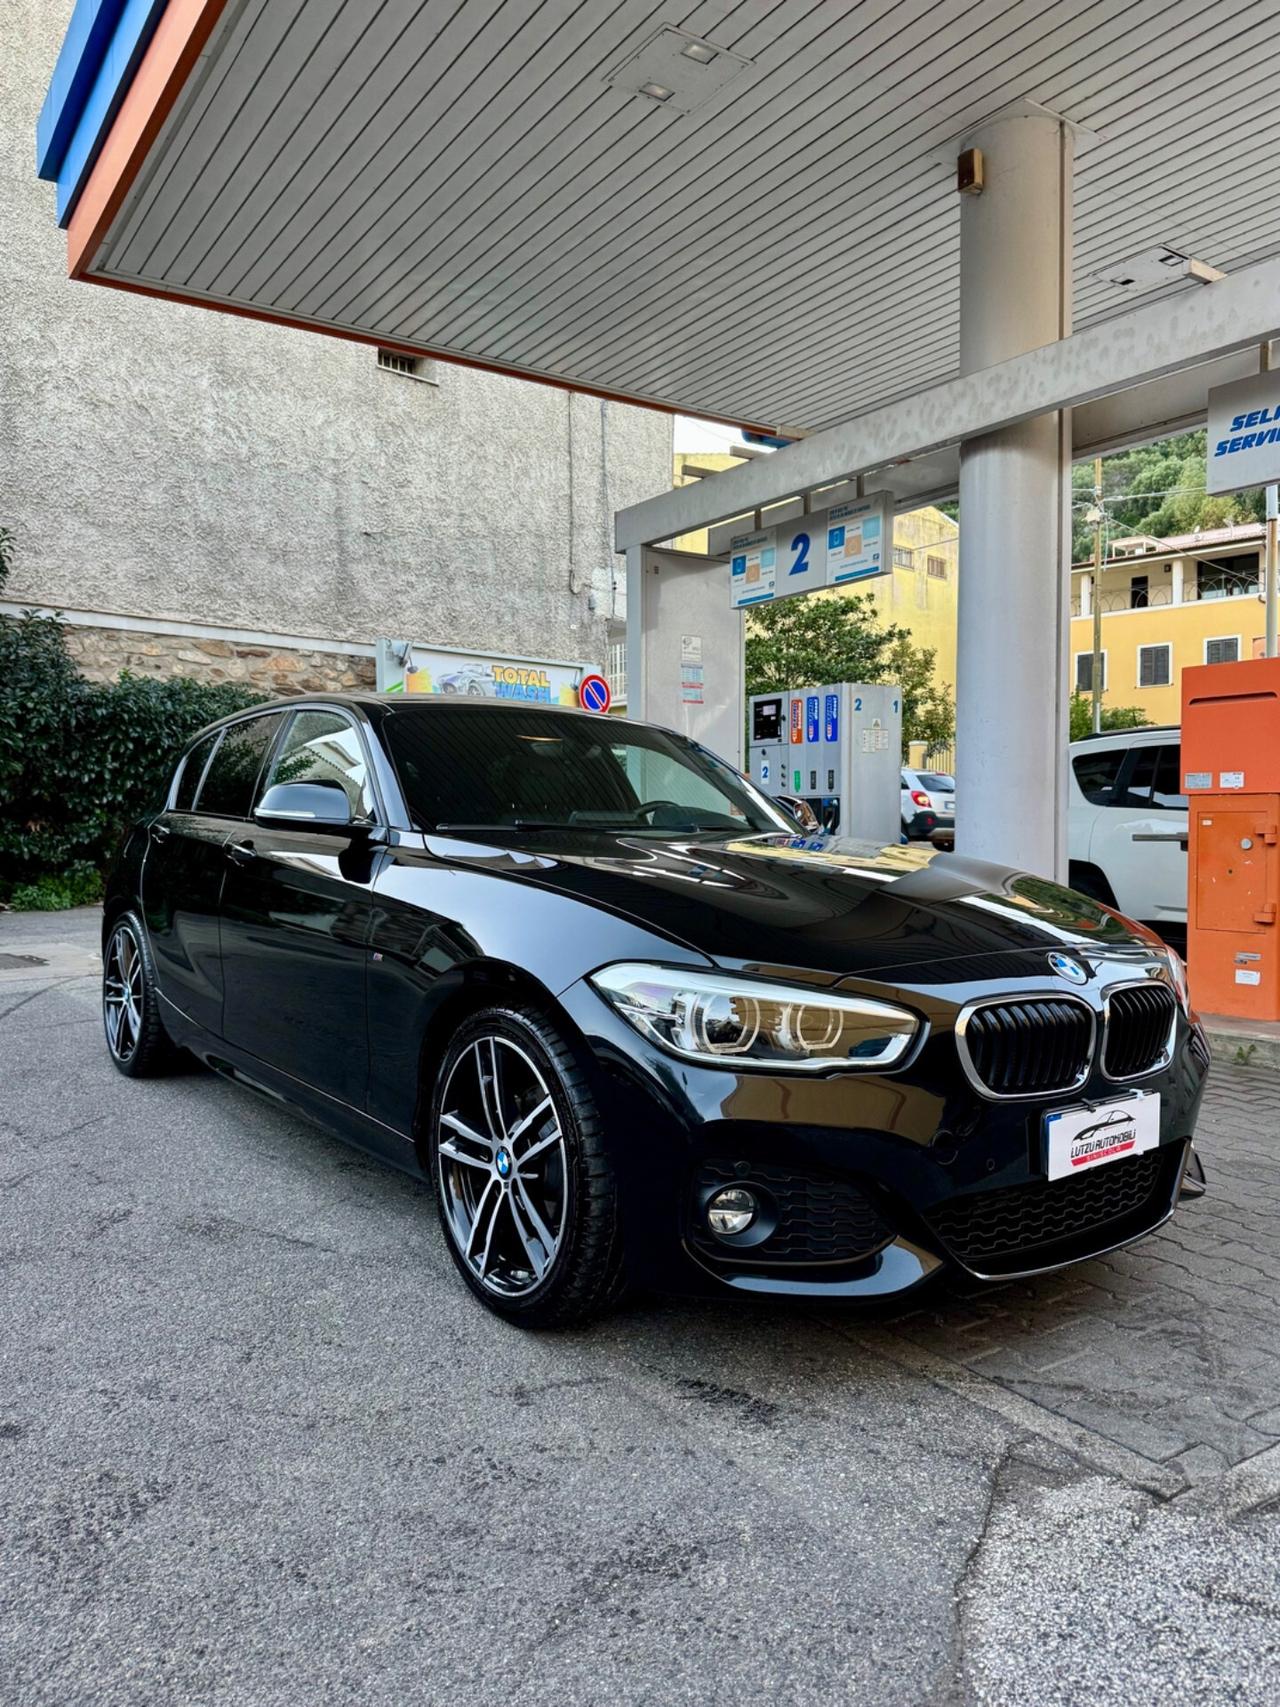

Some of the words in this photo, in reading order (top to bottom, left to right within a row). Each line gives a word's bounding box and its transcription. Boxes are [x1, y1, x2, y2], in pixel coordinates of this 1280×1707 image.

[788, 532, 810, 576] 2
[492, 665, 551, 688] TOTAL
[495, 682, 551, 704] WASH
[854, 698, 862, 711] 2
[893, 700, 898, 713] 1
[762, 766, 769, 779] 2
[1070, 1141, 1095, 1158] LUTZU
